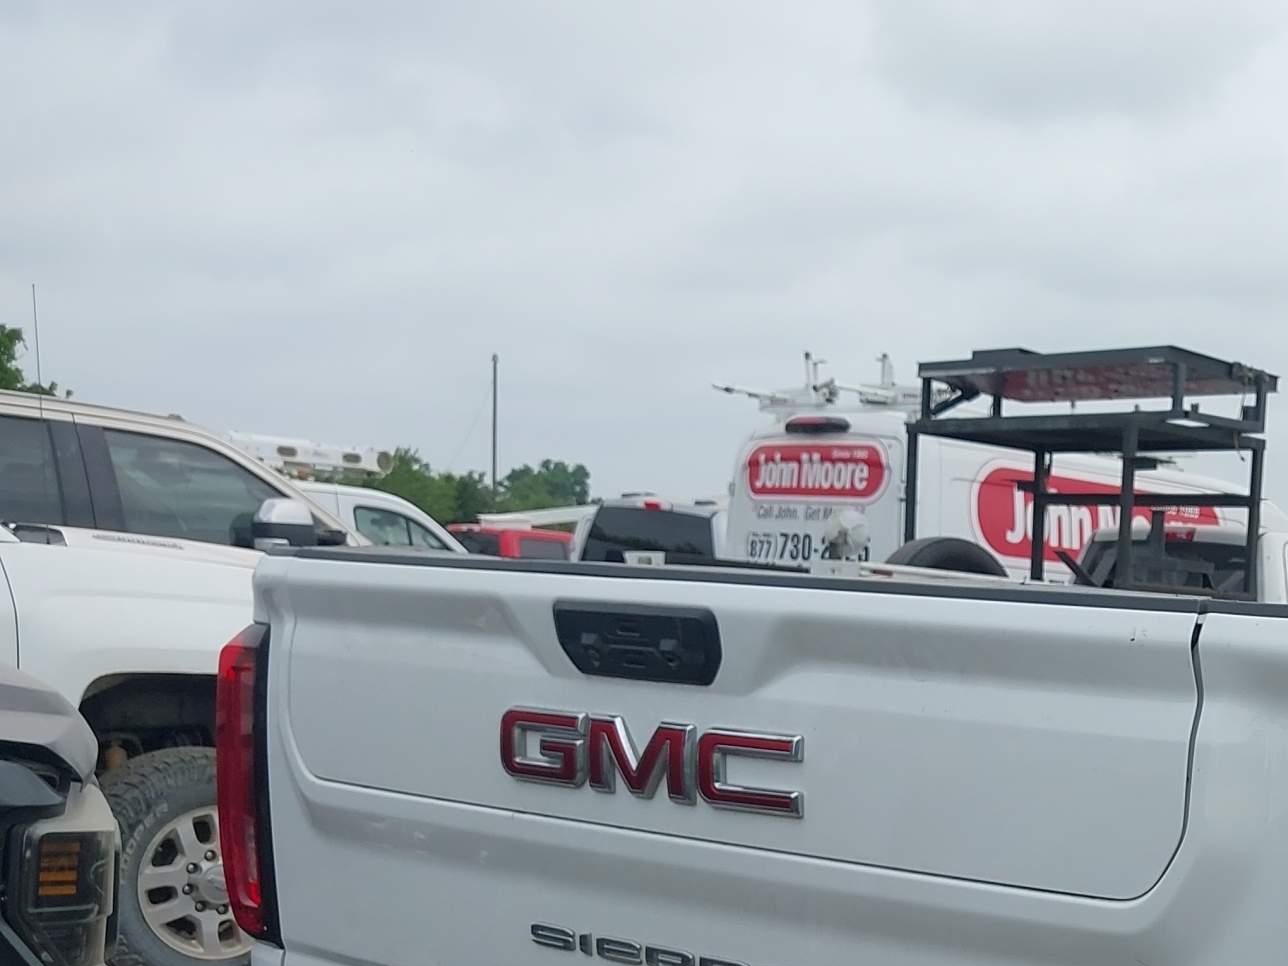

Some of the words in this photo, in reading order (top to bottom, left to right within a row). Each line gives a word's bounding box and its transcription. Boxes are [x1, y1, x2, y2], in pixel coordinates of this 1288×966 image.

[755, 453, 799, 489] John
[802, 452, 869, 490] Moore
[779, 532, 871, 563] 730-2
[500, 704, 805, 819] GMC
